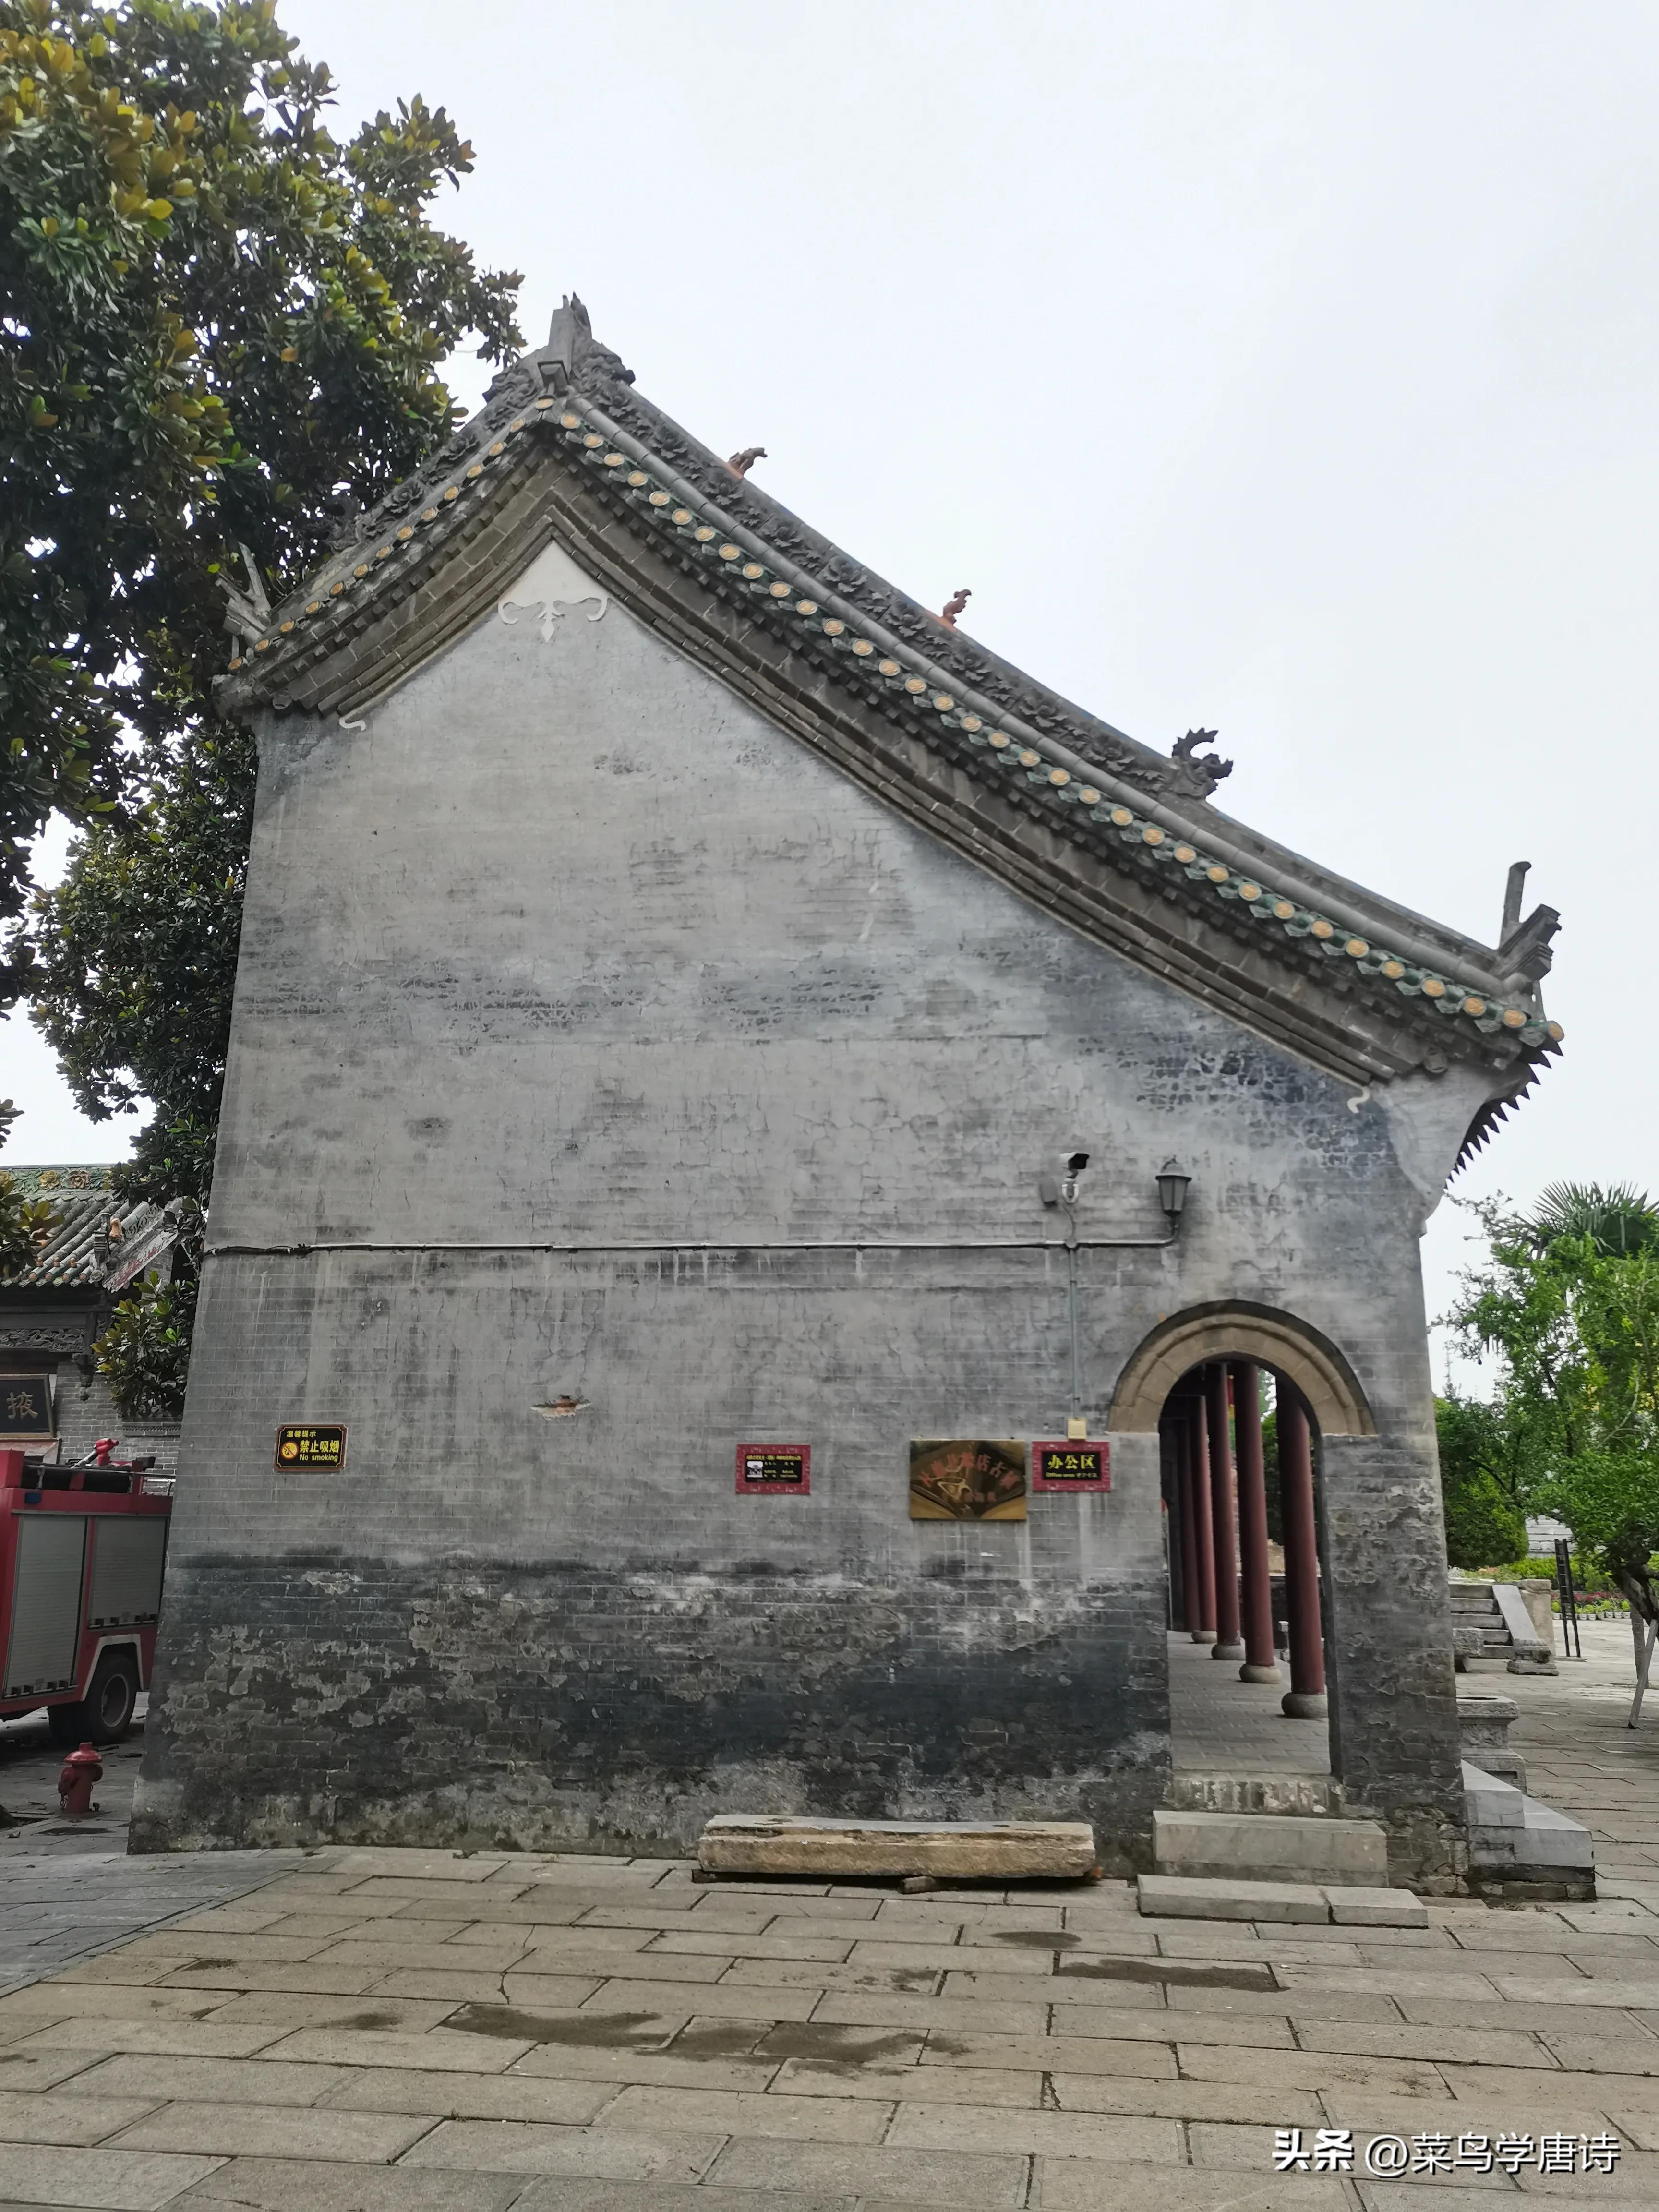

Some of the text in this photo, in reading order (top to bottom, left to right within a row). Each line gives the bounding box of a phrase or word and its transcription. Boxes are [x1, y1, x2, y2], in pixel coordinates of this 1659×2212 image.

[287, 1430, 316, 1438] 温馨提示
[300, 1440, 340, 1453] 禁止吸烟
[312, 1454, 338, 1462] smoking
[1047, 1454, 1096, 1469] 办公区
